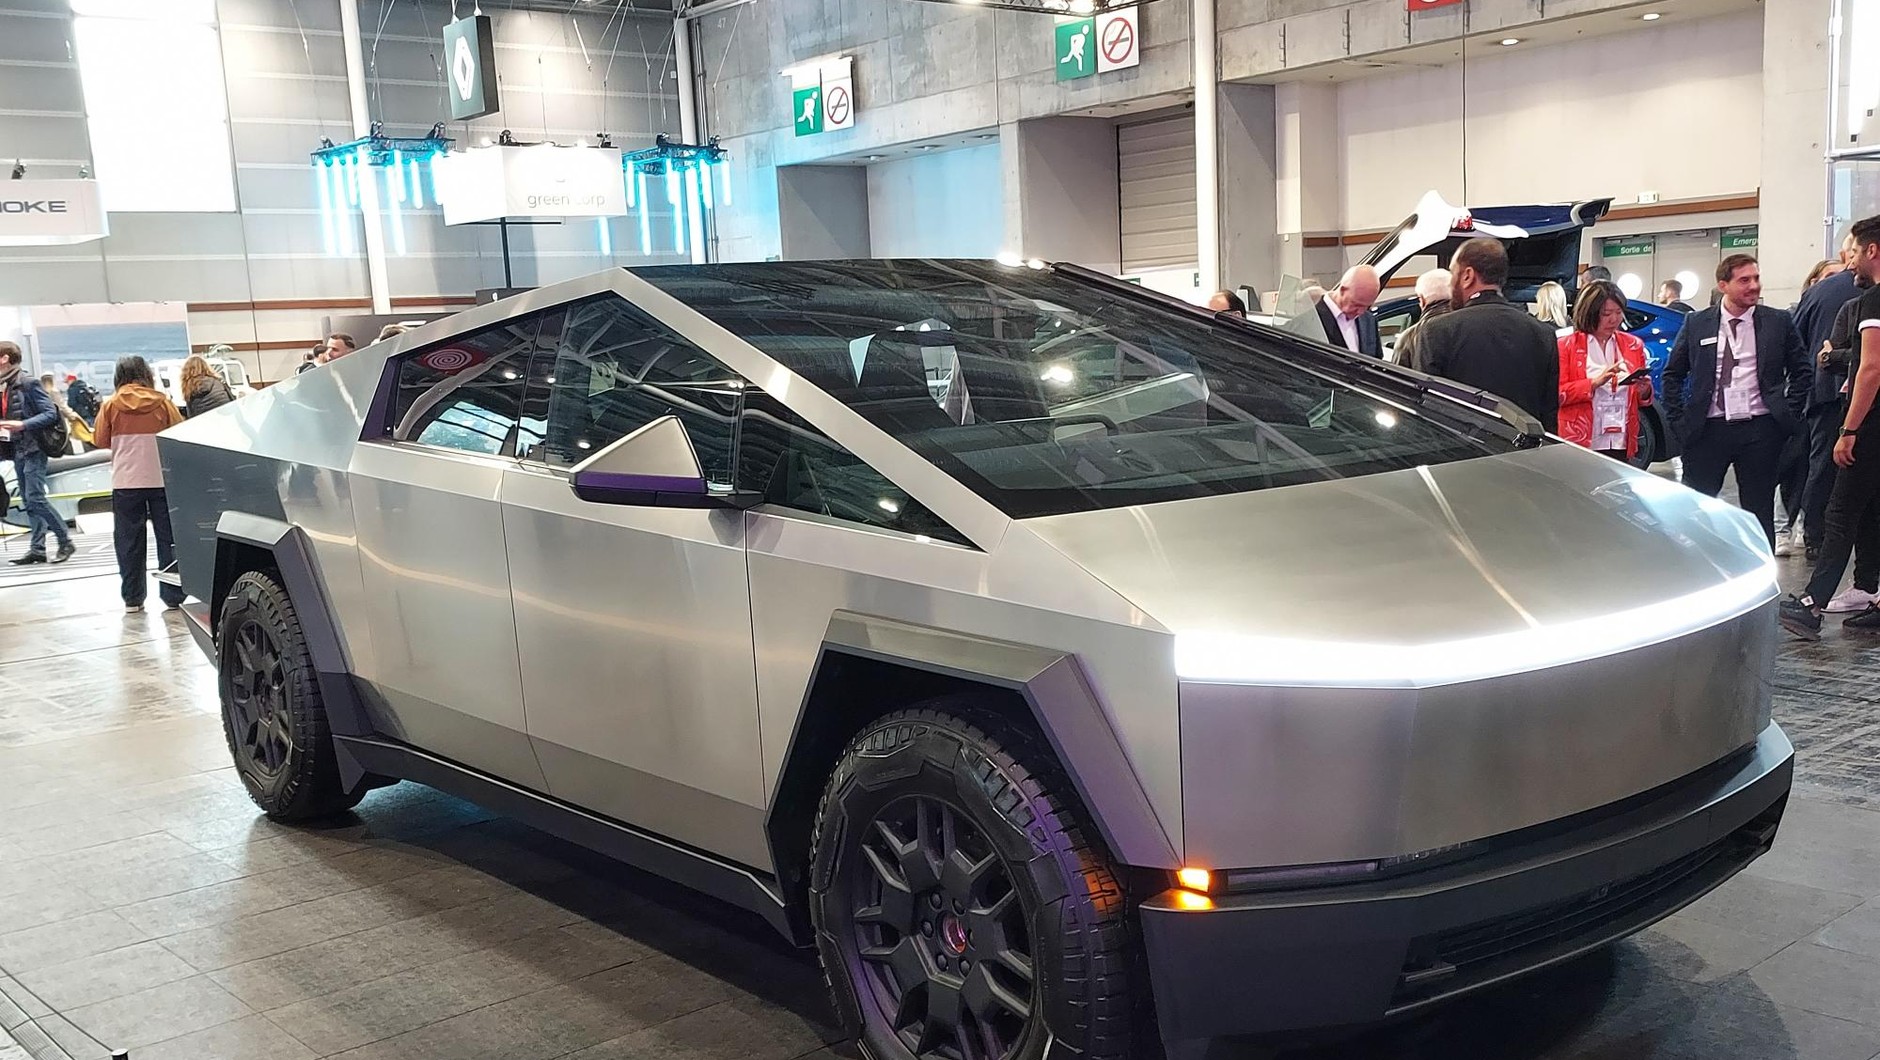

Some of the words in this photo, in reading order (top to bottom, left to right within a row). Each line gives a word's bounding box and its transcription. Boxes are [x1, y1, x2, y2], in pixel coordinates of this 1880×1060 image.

[527, 195, 569, 208] green
[0, 201, 67, 213] OKE
[1733, 238, 1757, 246] Emerg
[1620, 246, 1640, 254] Sortie
